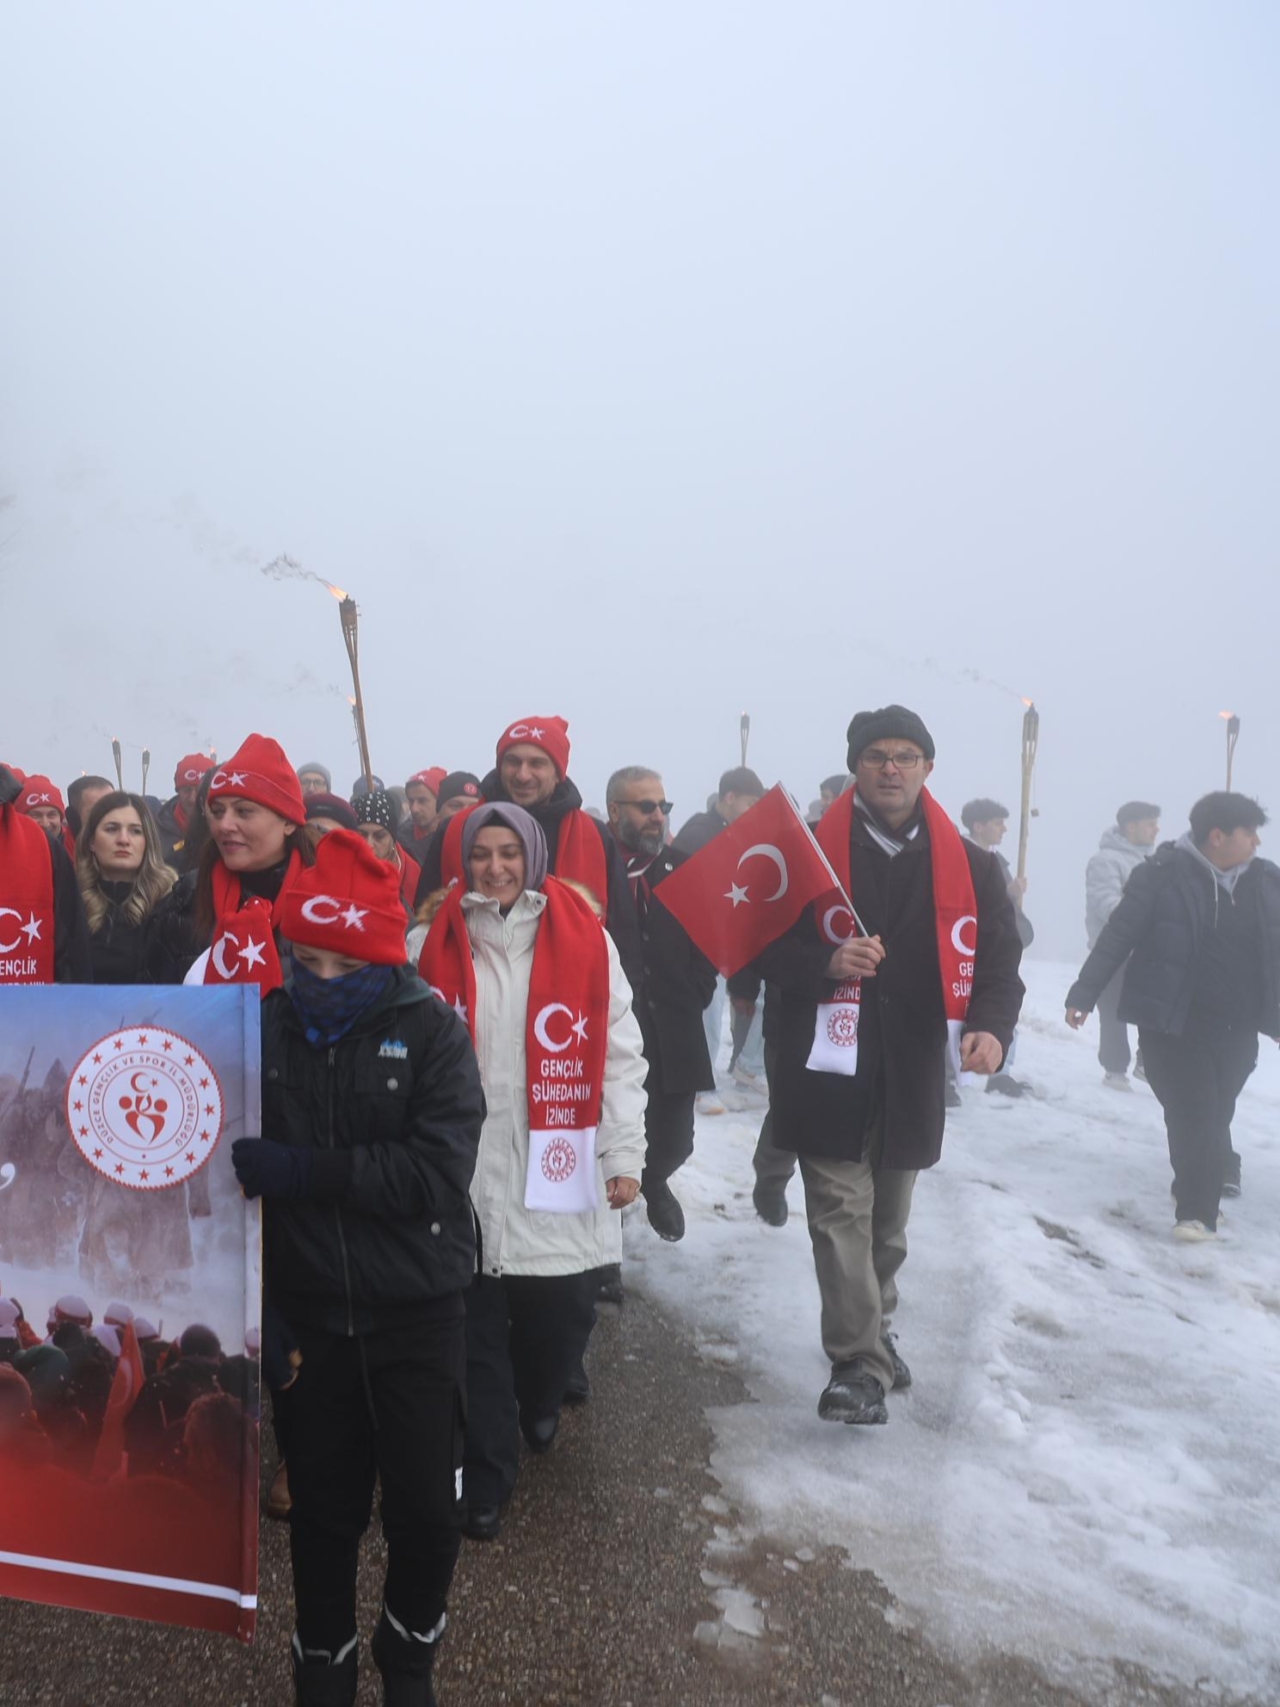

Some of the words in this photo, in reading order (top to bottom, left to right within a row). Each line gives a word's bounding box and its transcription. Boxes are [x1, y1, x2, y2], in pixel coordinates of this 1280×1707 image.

[122, 1056, 135, 1066] VE
[139, 1056, 166, 1069] SPOR
[541, 1056, 583, 1080] GENÇLİK
[532, 1080, 591, 1104] ŞÜHEDANIN
[545, 1104, 576, 1126] İZİNDE
